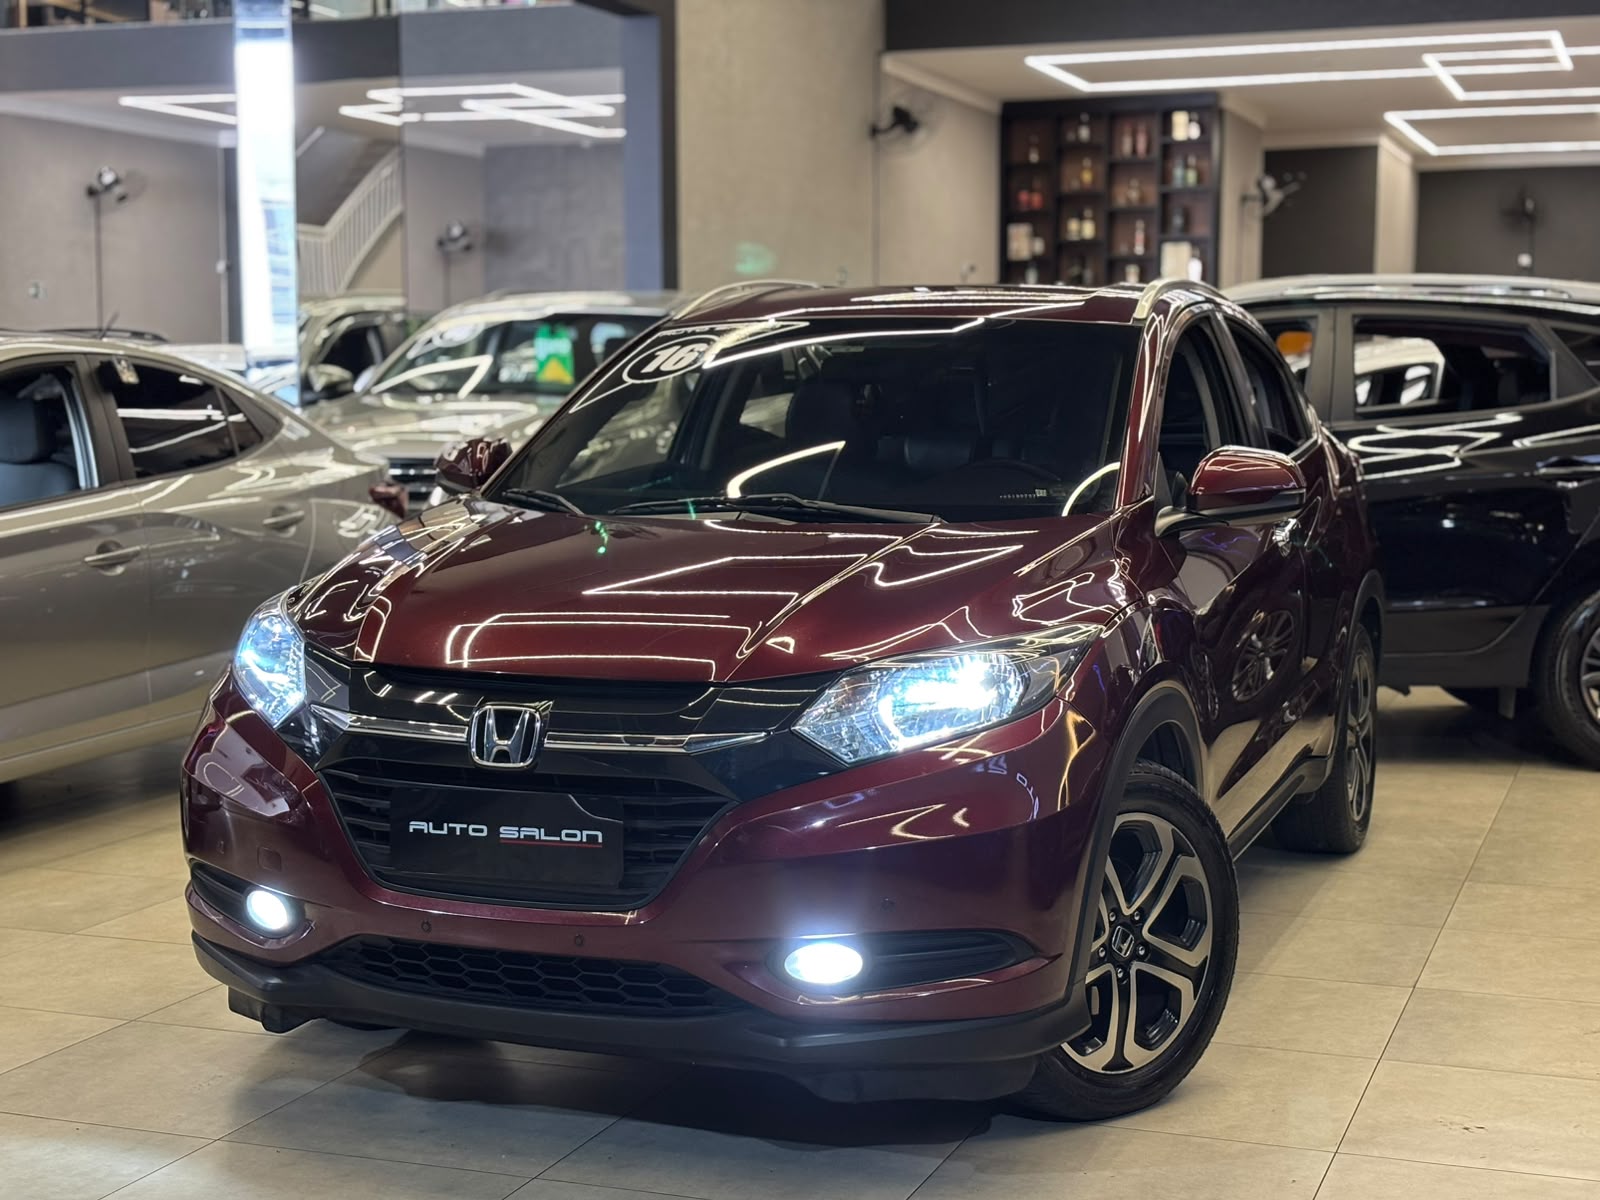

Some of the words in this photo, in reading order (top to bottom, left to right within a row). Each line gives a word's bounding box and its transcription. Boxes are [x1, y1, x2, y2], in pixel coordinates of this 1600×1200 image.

[640, 343, 709, 373] 16
[409, 821, 488, 837] AUTO
[499, 826, 603, 843] SALON
